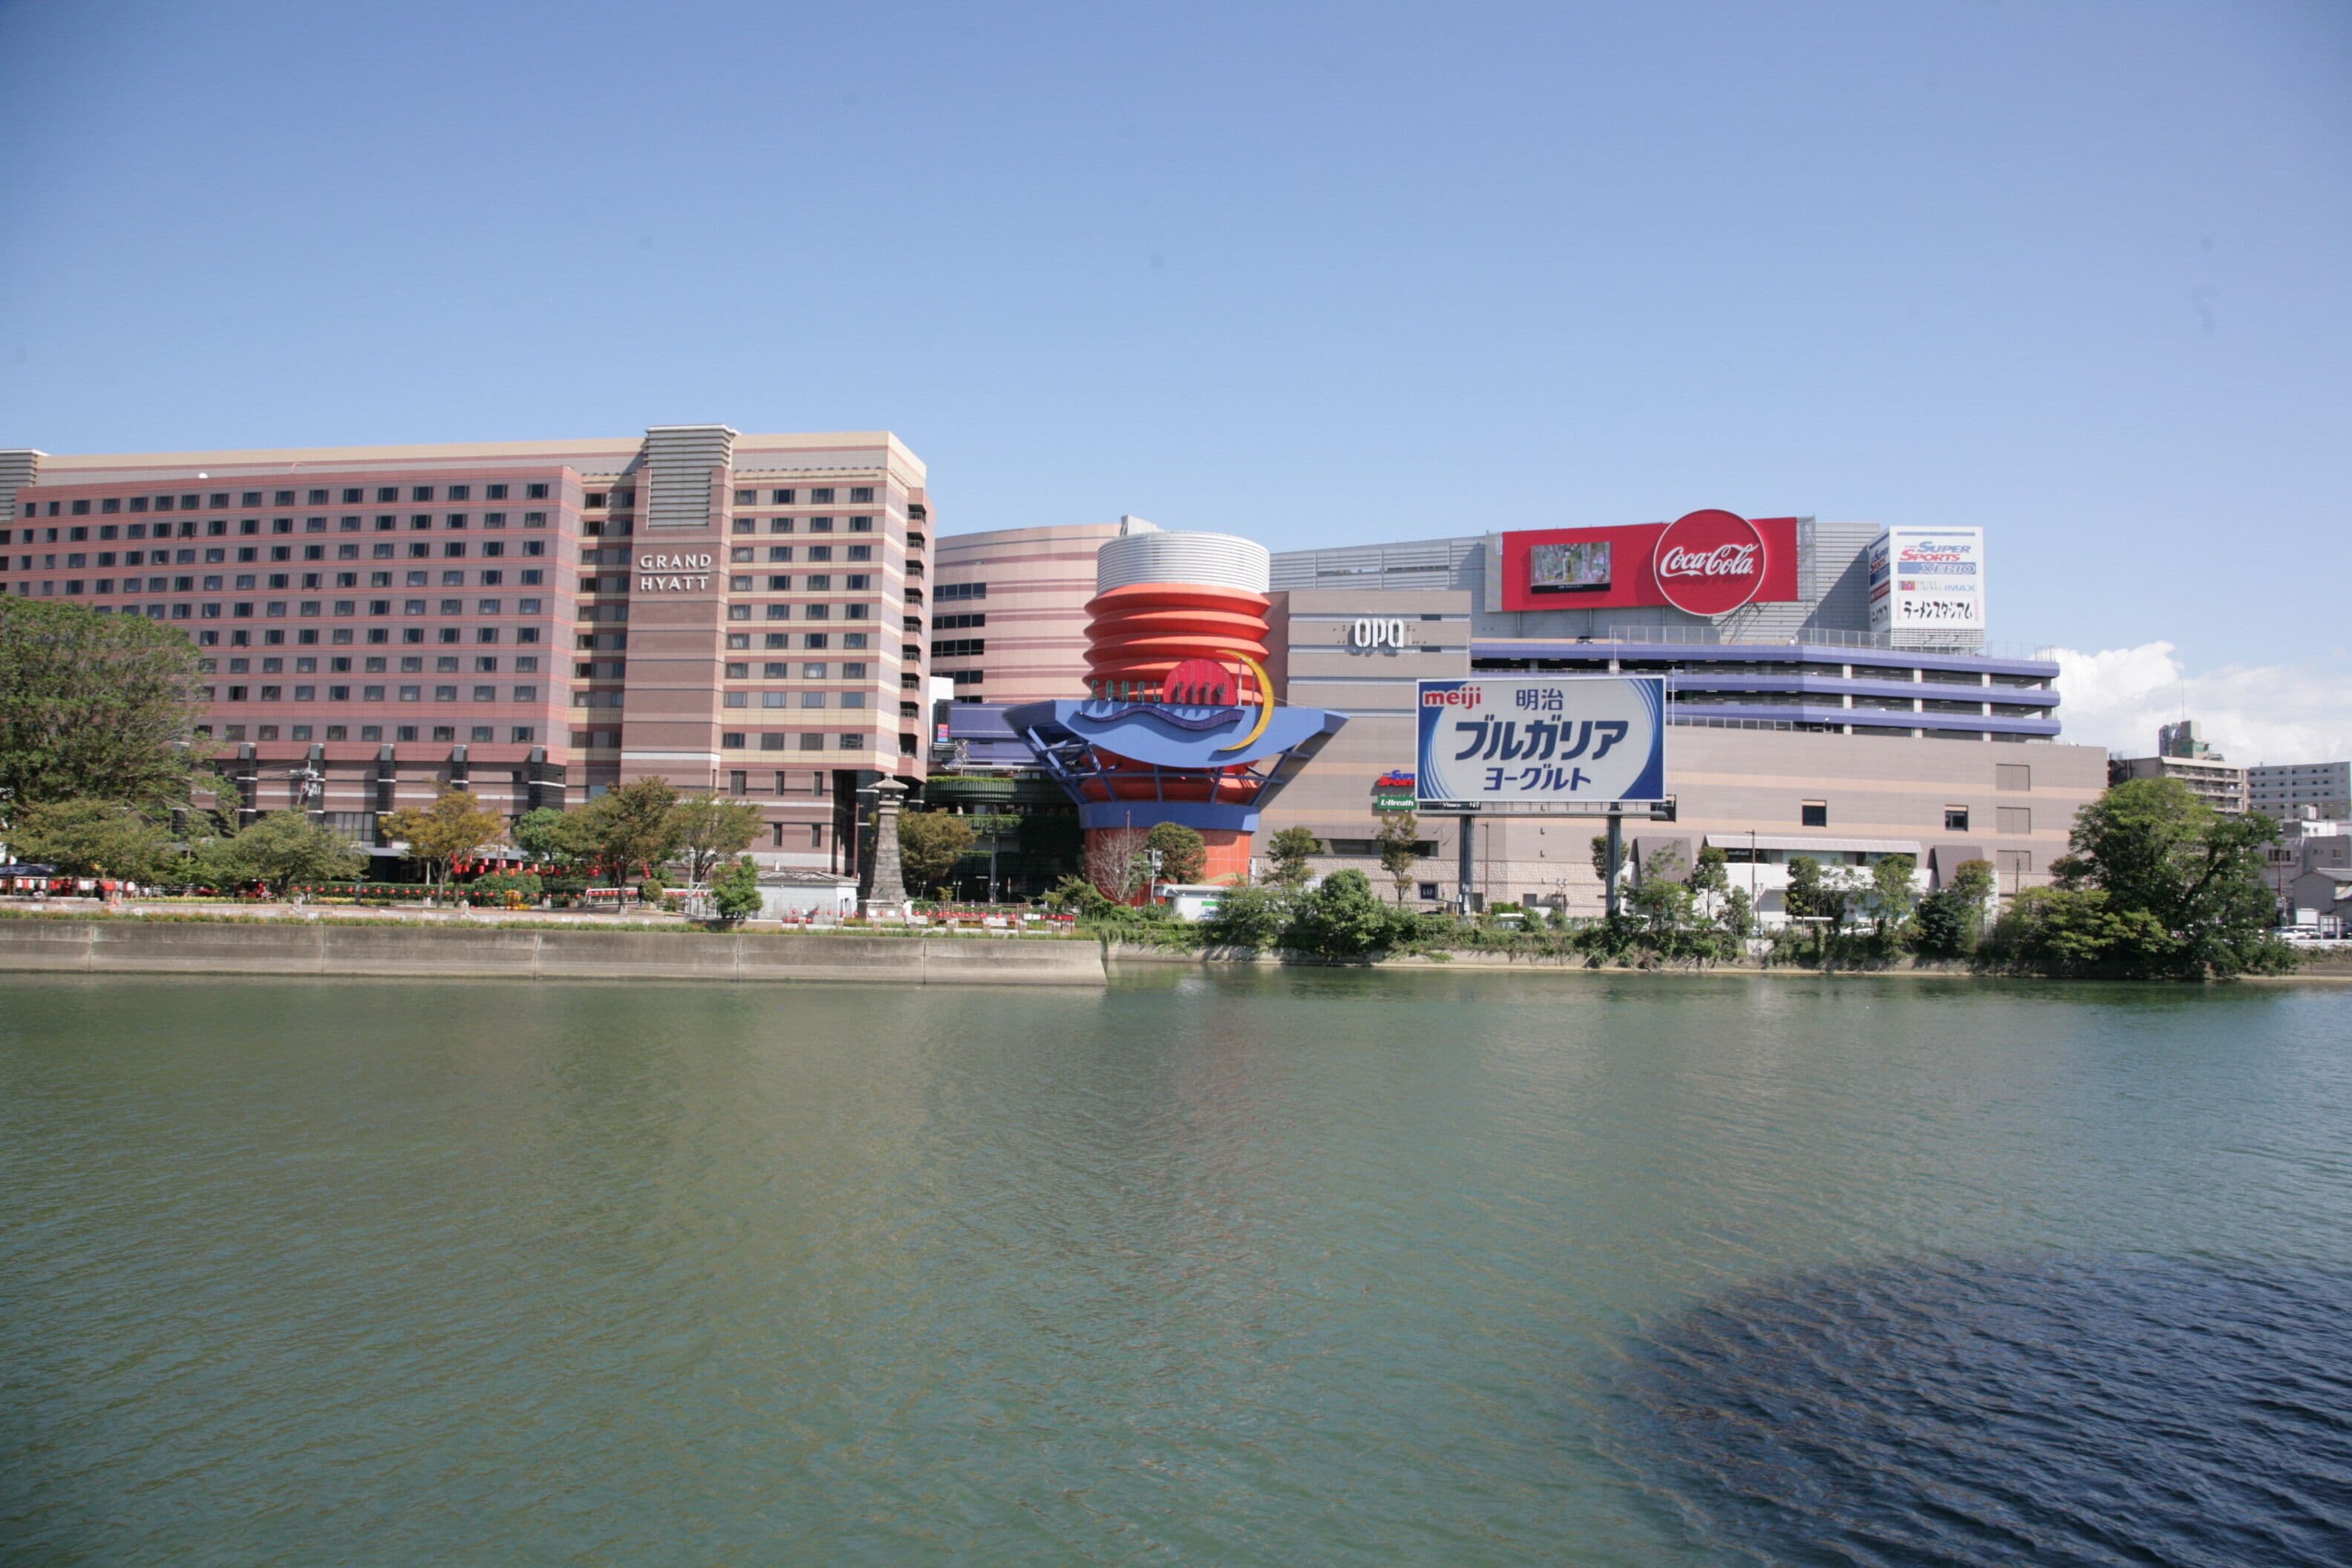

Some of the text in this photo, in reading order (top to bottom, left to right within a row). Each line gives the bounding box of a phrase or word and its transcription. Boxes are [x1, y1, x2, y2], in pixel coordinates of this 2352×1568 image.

[1899, 549, 1961, 561] SPORTS
[1918, 541, 1971, 553] SUPER
[641, 554, 711, 568] GRAND
[641, 576, 709, 590] HYATT
[1944, 584, 1976, 592] IMAX
[1091, 679, 1226, 703] CANAL CITY
[1423, 687, 1482, 709] meiji
[1515, 687, 1564, 710] 明治
[1454, 713, 1629, 761] ブルガリア
[1483, 763, 1592, 791] ヨーグルト
